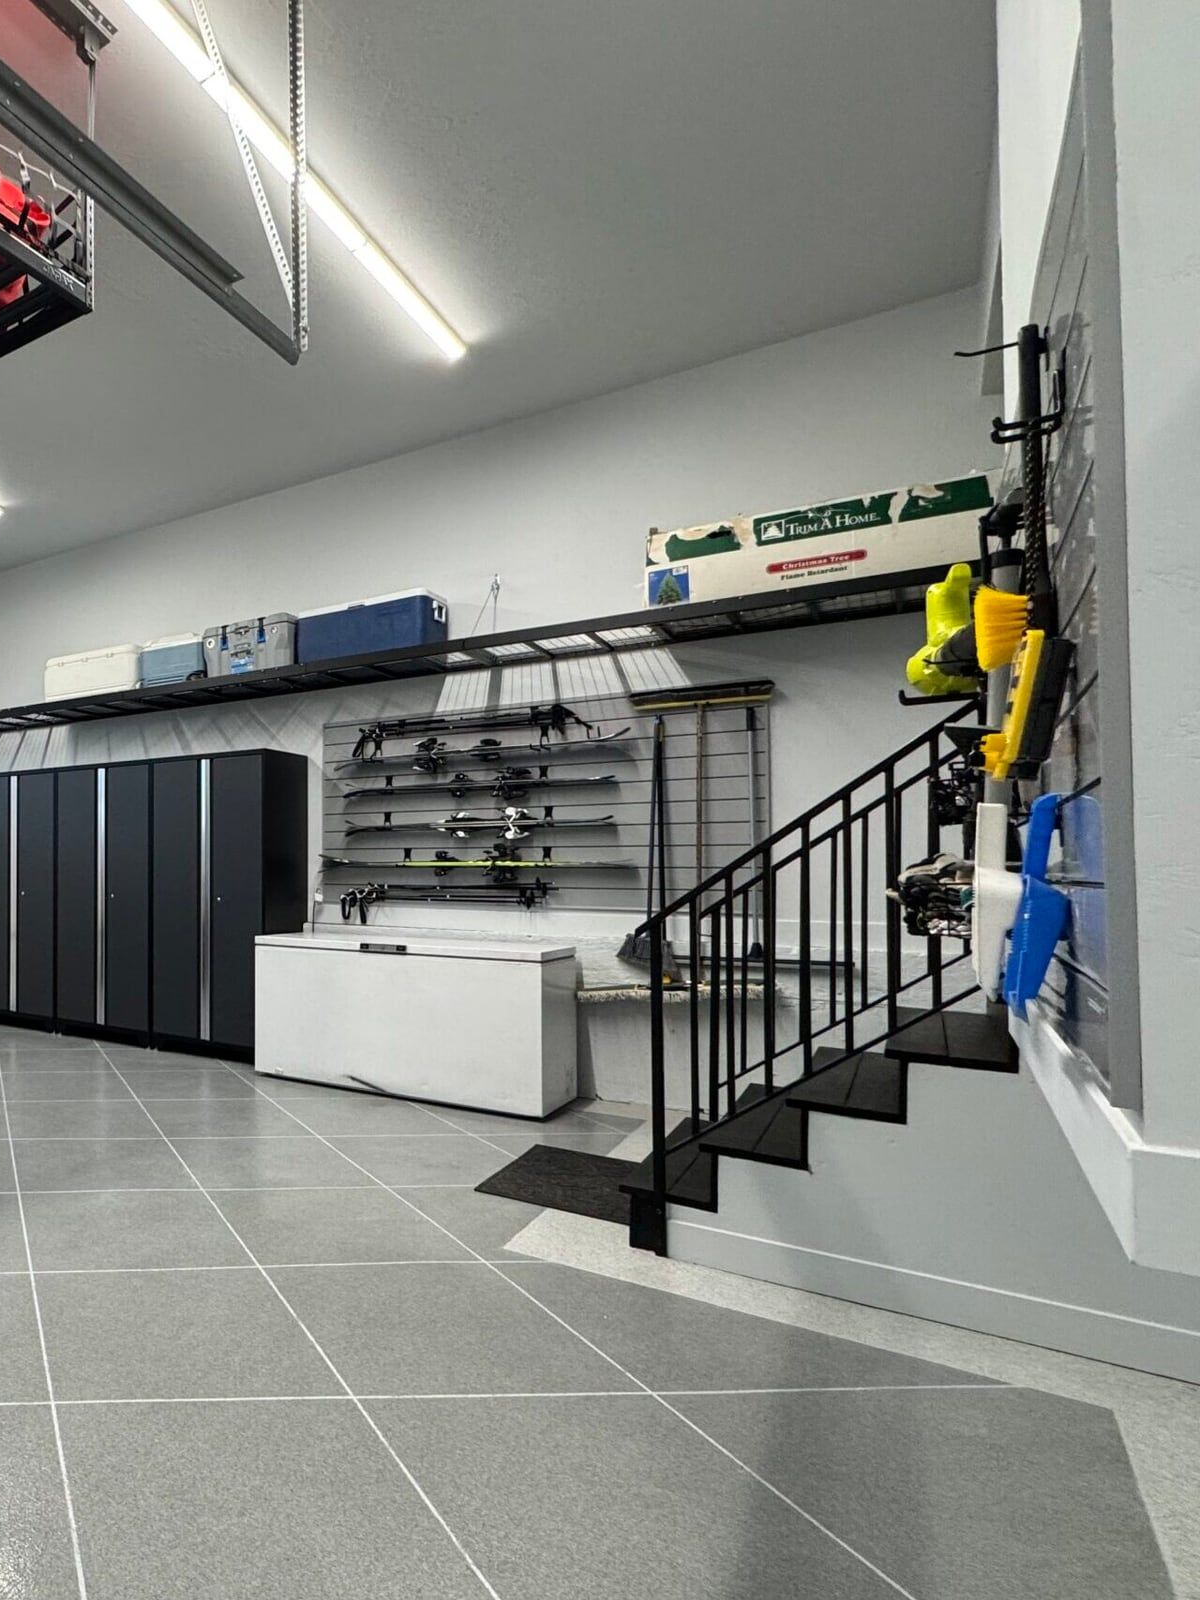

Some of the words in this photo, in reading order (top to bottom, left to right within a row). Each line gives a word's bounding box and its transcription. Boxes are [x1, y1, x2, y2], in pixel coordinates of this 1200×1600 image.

[820, 518, 832, 530] A
[782, 558, 828, 570] Christmas
[830, 554, 851, 563] Tree
[781, 571, 806, 581] Flame
[807, 565, 848, 577] Retardant
